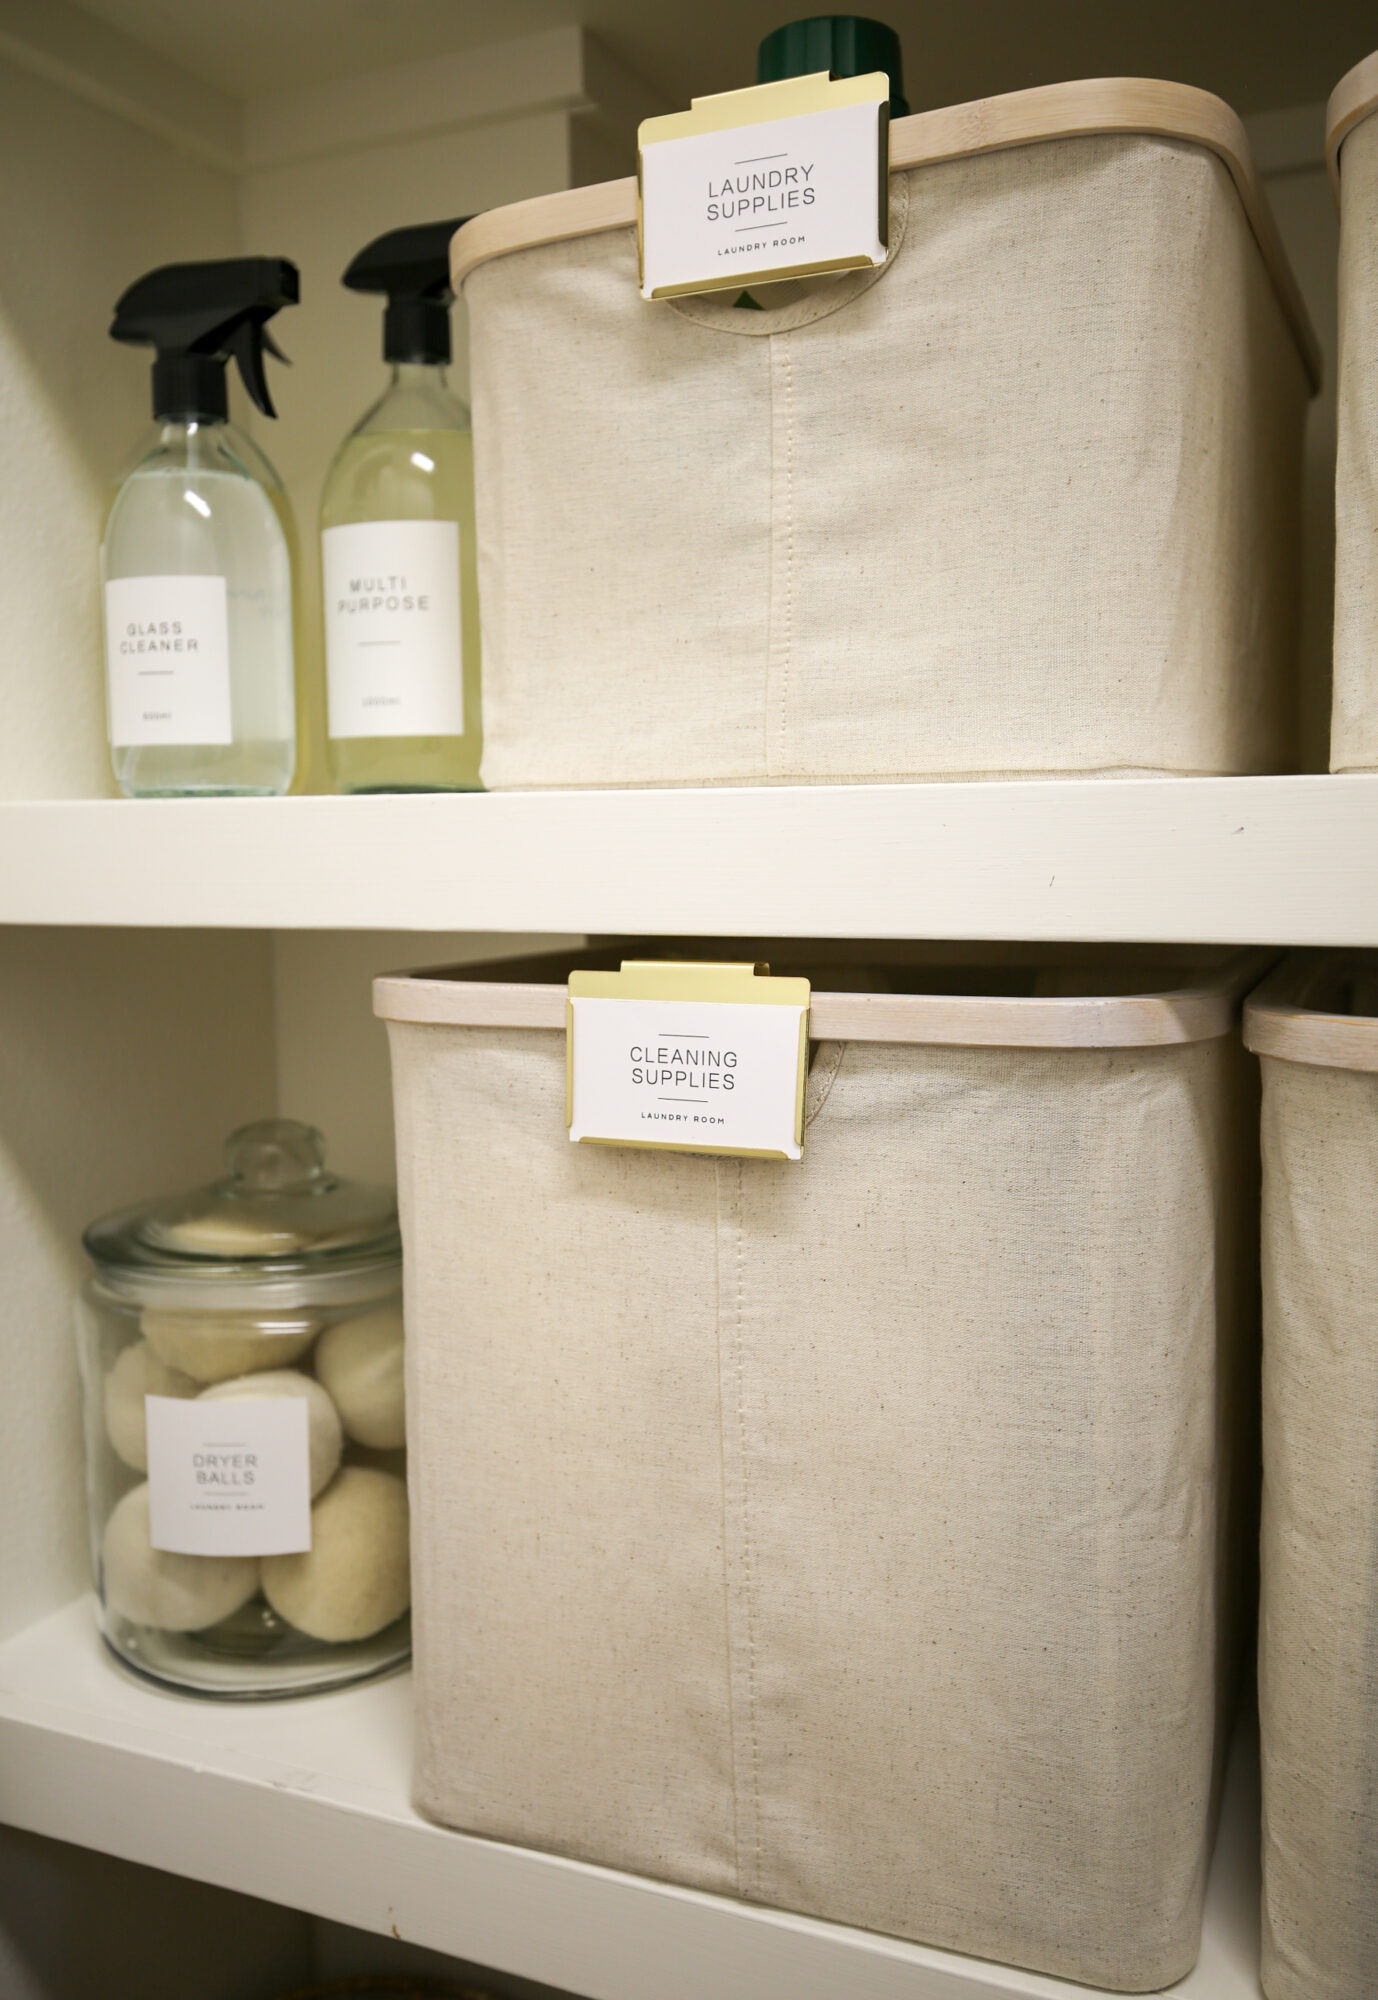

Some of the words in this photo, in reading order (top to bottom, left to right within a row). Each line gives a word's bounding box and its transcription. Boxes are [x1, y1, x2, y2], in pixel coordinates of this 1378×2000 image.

[708, 163, 815, 198] LAUNDRY
[706, 187, 816, 221] SUPPLIES
[717, 241, 767, 256] LAUNDRY
[772, 235, 806, 247] ROOM
[349, 575, 407, 593] MULTI
[337, 595, 430, 615] PURPOSE
[125, 621, 183, 637] GLASS
[119, 638, 199, 655] CLEANER
[629, 1046, 738, 1068] CLEANING
[631, 1068, 736, 1091] SUPPLIES
[641, 1111, 689, 1123] LAUNDRY
[693, 1115, 725, 1125] ROOM
[192, 1453, 259, 1469] DRYER
[195, 1470, 256, 1486] BALLS
